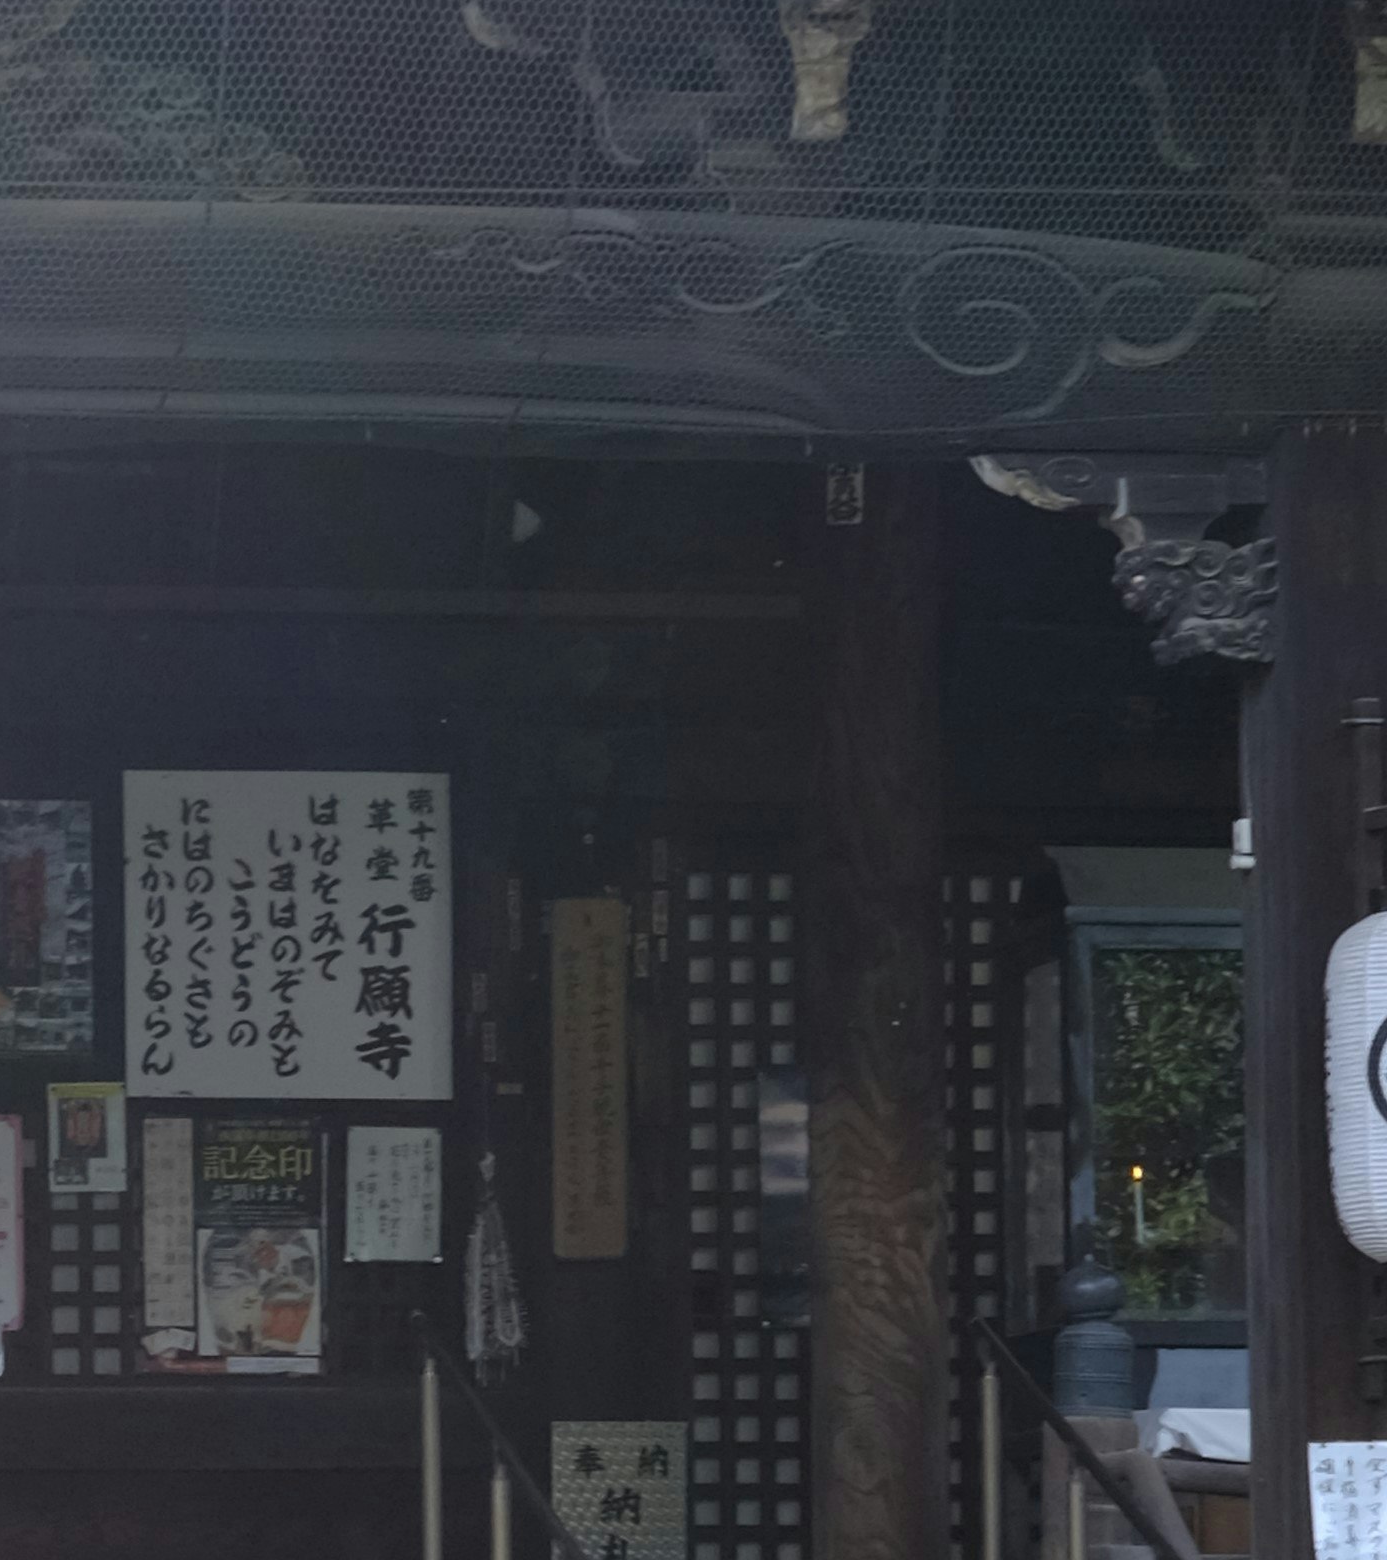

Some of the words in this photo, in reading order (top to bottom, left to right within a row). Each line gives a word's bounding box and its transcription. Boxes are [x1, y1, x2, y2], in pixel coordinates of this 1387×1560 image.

[307, 793, 345, 981] はなをみて
[406, 787, 438, 902] 第十九番
[138, 823, 175, 1077] さかりなるらん
[227, 856, 265, 1048] こうどうの
[354, 902, 417, 1080] 行願寺
[202, 1144, 314, 1181] 記念印
[574, 1444, 668, 1478] 奉納
